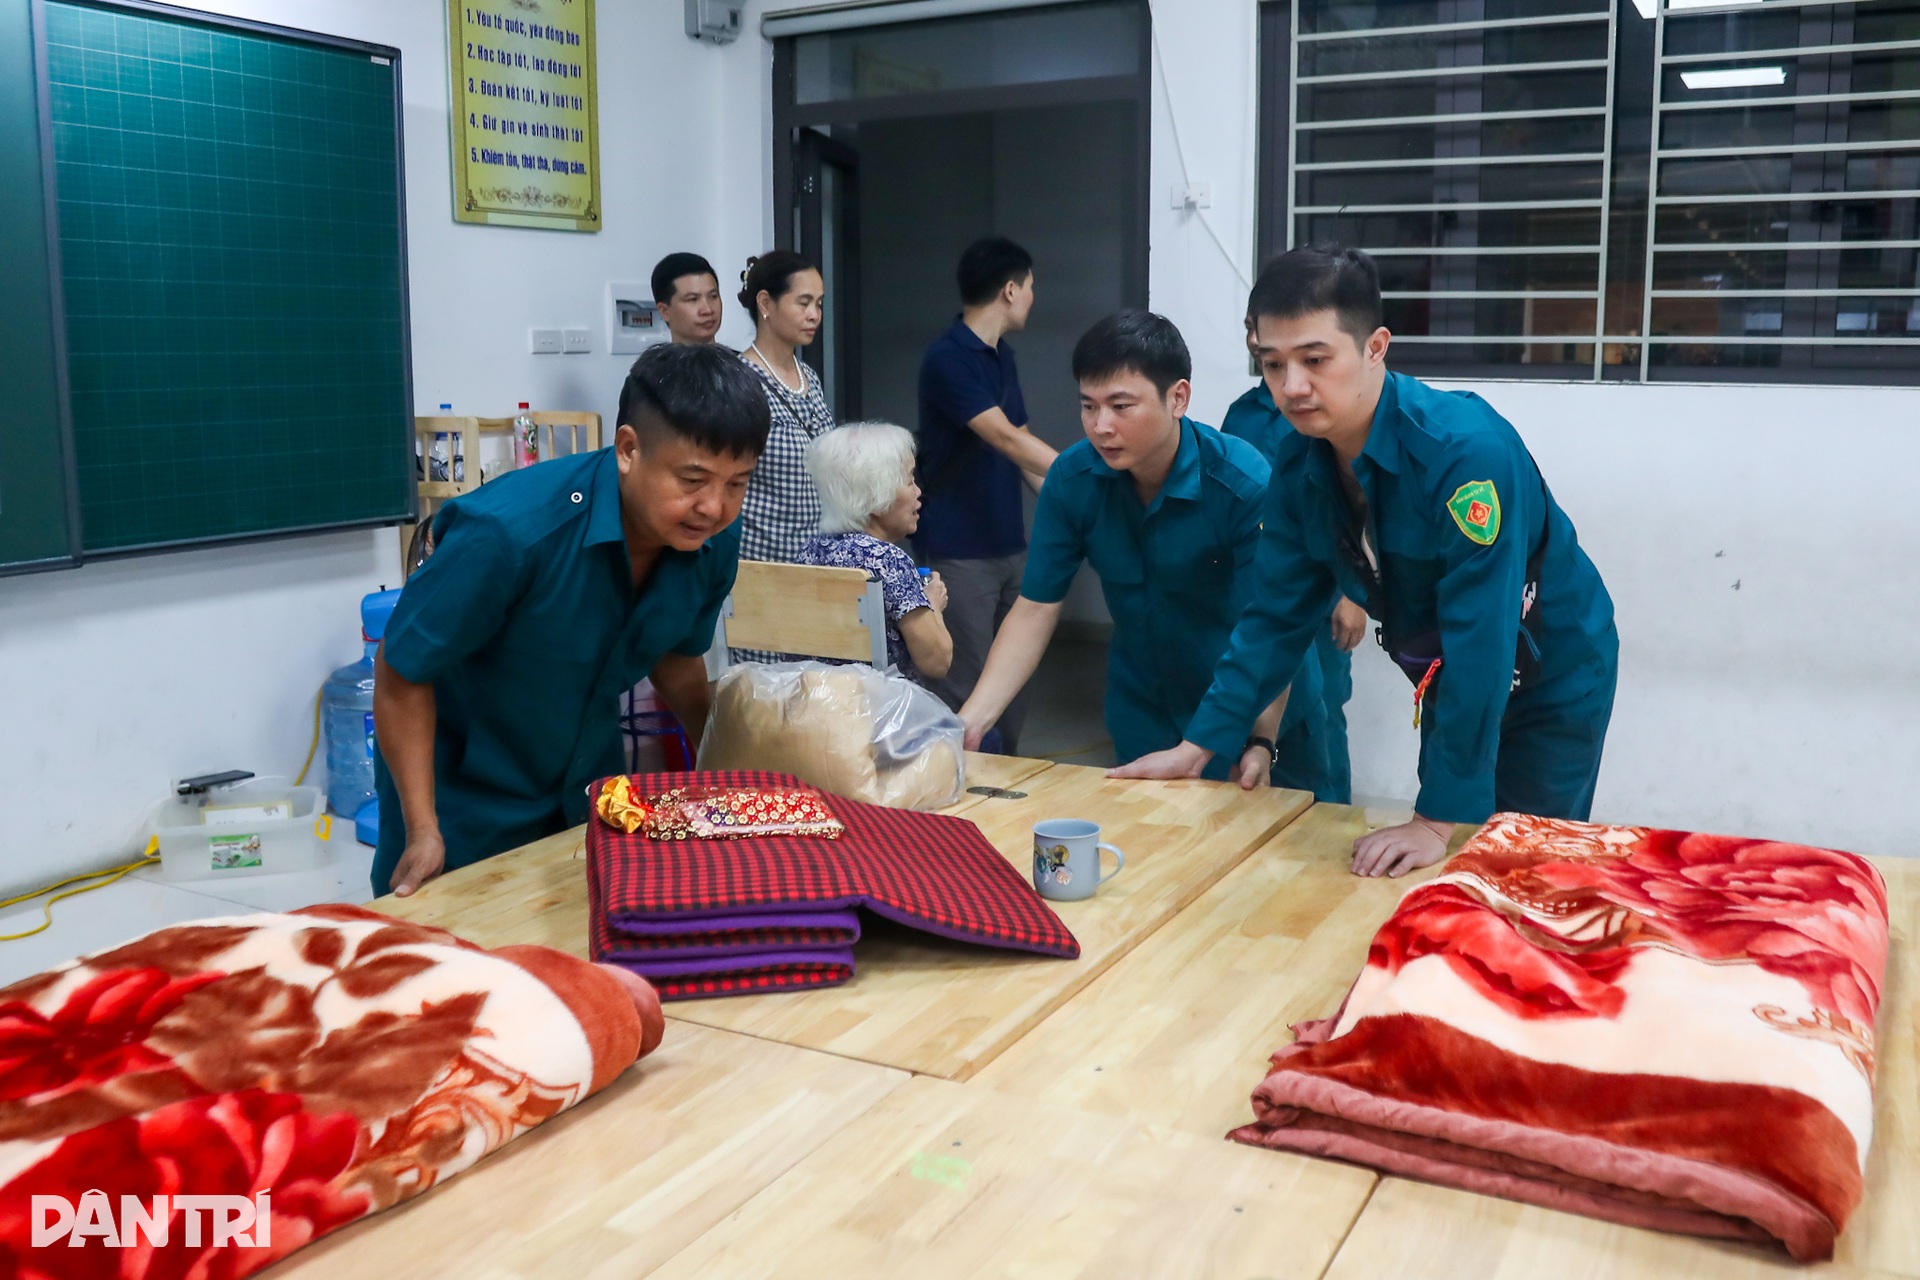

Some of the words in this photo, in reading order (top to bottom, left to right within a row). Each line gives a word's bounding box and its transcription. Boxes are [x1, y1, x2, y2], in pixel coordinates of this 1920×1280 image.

[467, 8, 474, 24] 1.
[467, 43, 475, 58] 2.
[469, 78, 477, 94] 3.
[470, 113, 479, 128] 4.
[532, 122, 549, 138] sinh
[472, 148, 479, 162] 5.
